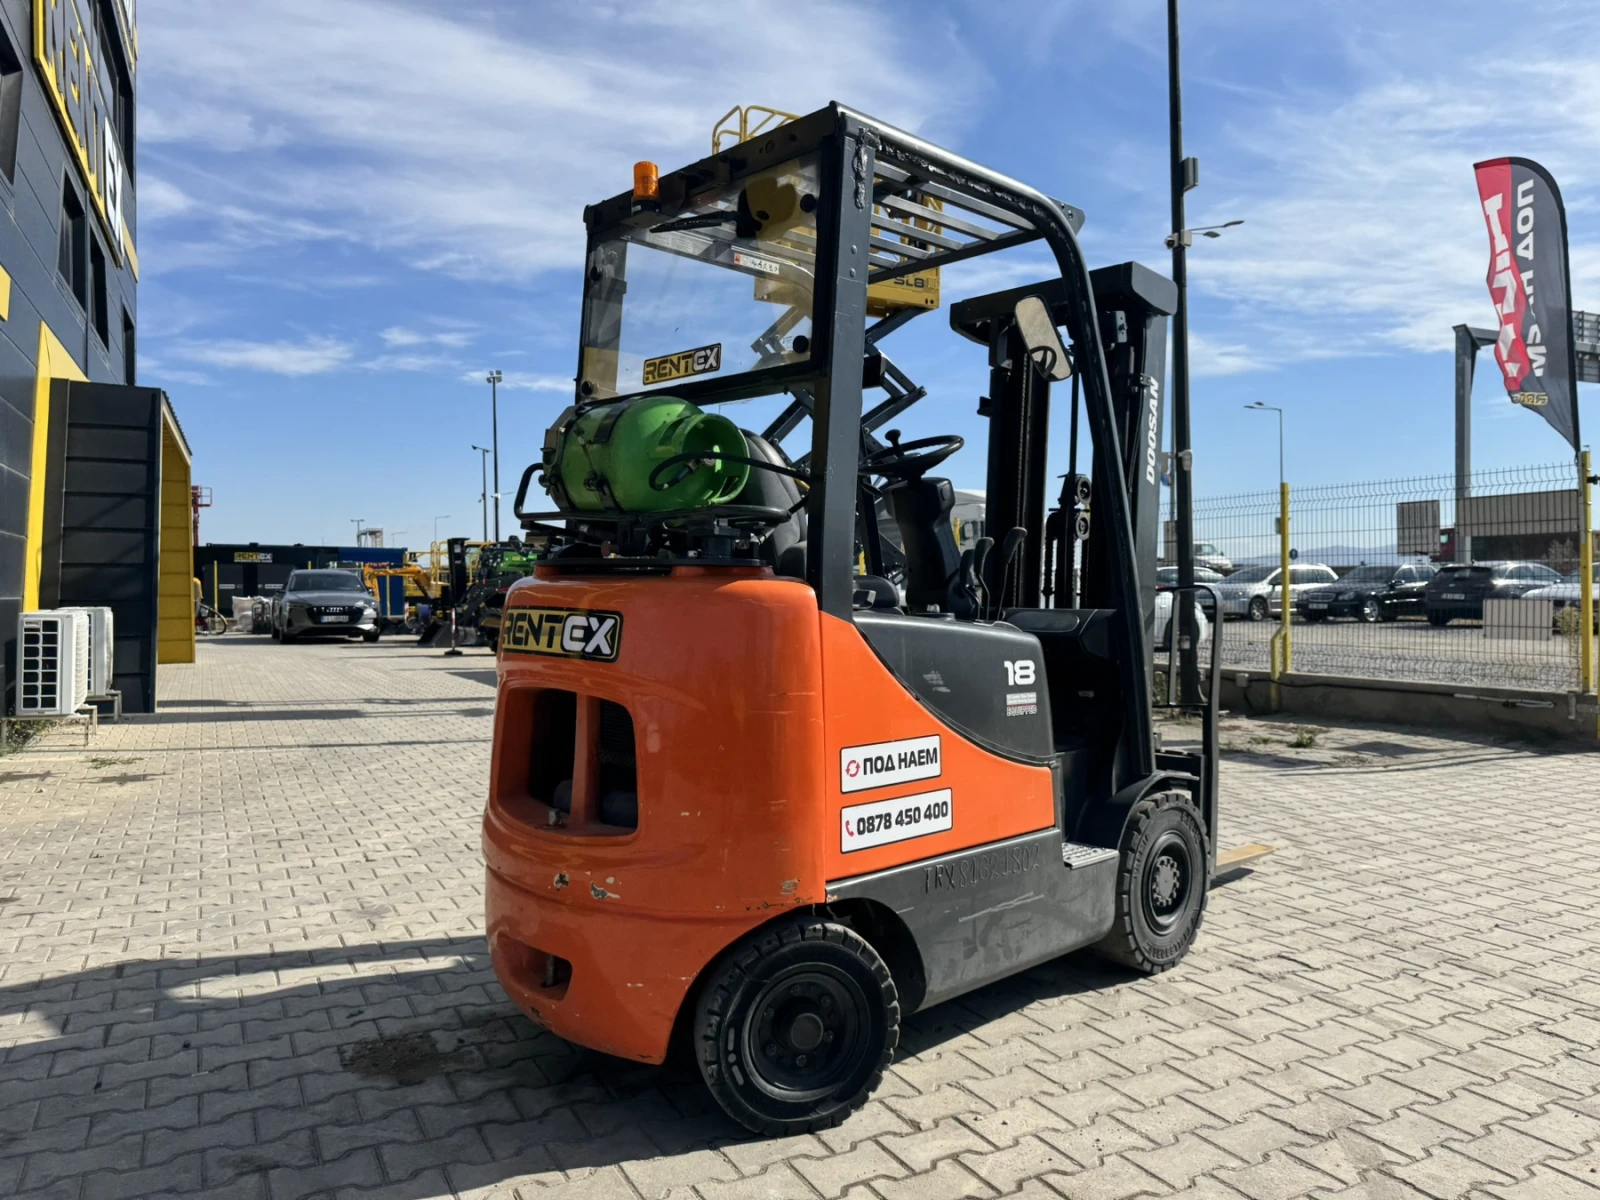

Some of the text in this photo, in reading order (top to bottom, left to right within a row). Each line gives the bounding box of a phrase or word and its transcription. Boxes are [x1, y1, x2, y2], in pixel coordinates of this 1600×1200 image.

[893, 276, 925, 288] SL8
[645, 348, 718, 381] RENTEX
[1146, 376, 1159, 485] DOOSAN
[502, 612, 616, 655] RENTEX
[1004, 660, 1036, 685] 18
[863, 747, 938, 775] ПОД НАЕМ
[857, 801, 949, 835] 0878 450 400
